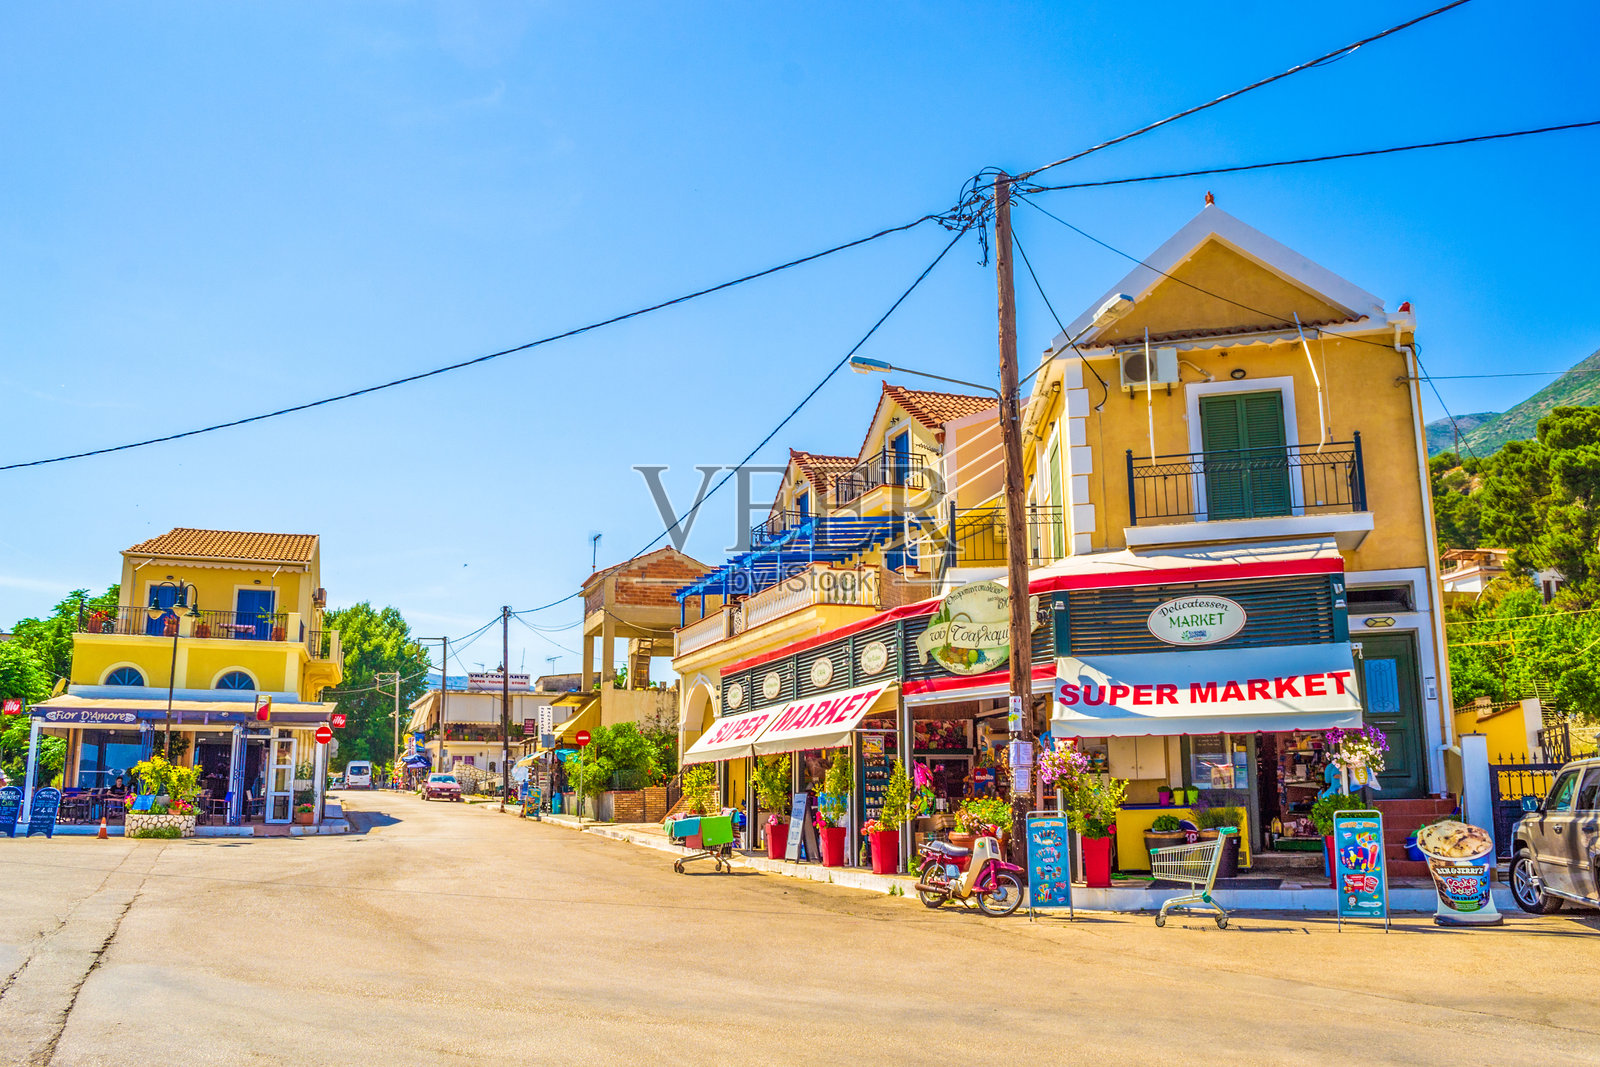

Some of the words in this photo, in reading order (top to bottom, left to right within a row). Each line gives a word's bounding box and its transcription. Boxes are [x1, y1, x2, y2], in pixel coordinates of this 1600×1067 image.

[1159, 599, 1230, 618] Delicatessen
[1169, 612, 1225, 629] MARKET
[1058, 682, 1180, 706] SUPER
[1189, 671, 1351, 705] MARKET
[4, 701, 20, 713] illy
[56, 710, 78, 720] Fior
[80, 710, 126, 721] D'Amore
[333, 716, 345, 725] illy
[707, 714, 770, 745] SUPER
[769, 688, 882, 733] MARKET
[1446, 877, 1478, 888] Cookie
[1451, 886, 1478, 896] Dough
